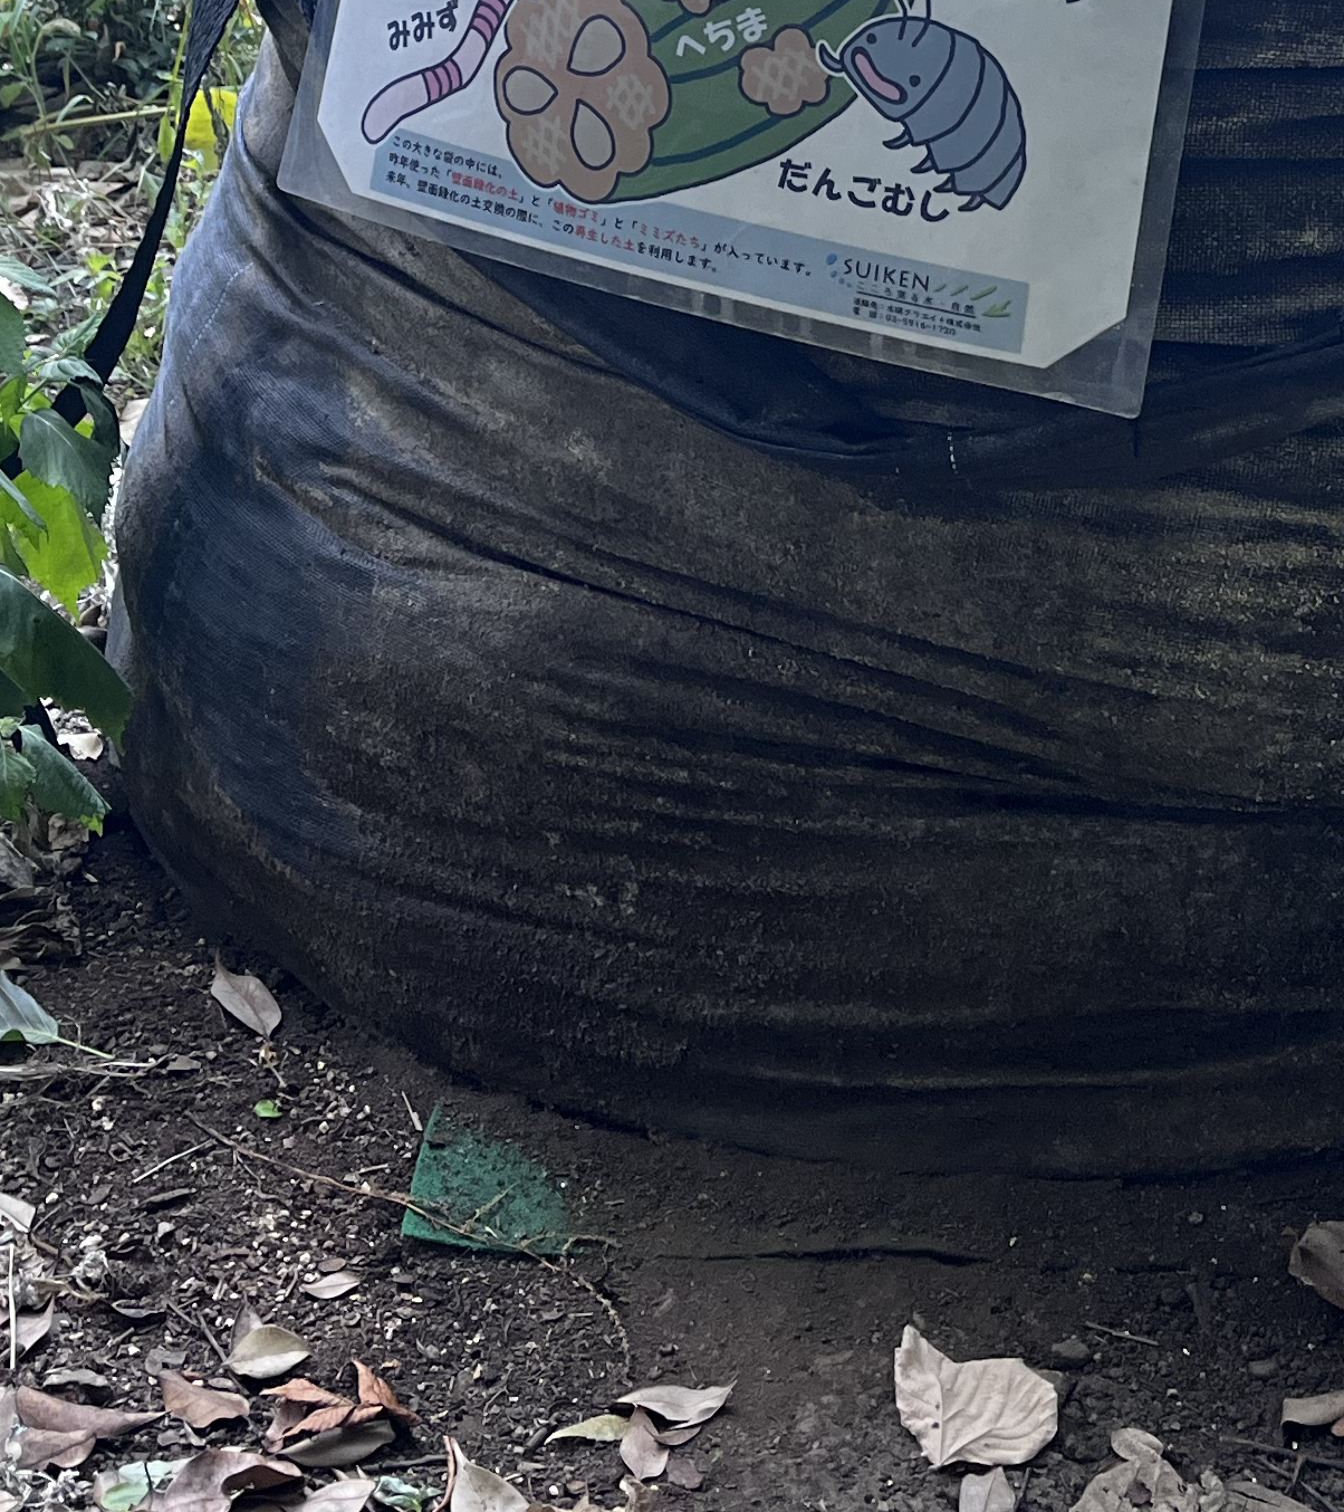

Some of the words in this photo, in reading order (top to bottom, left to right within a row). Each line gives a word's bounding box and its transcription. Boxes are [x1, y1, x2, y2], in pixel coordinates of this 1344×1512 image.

[387, 0, 459, 50] みみず
[676, 8, 768, 58] へちま
[777, 158, 950, 222] だんごむし
[843, 258, 930, 292] SUIKEN
